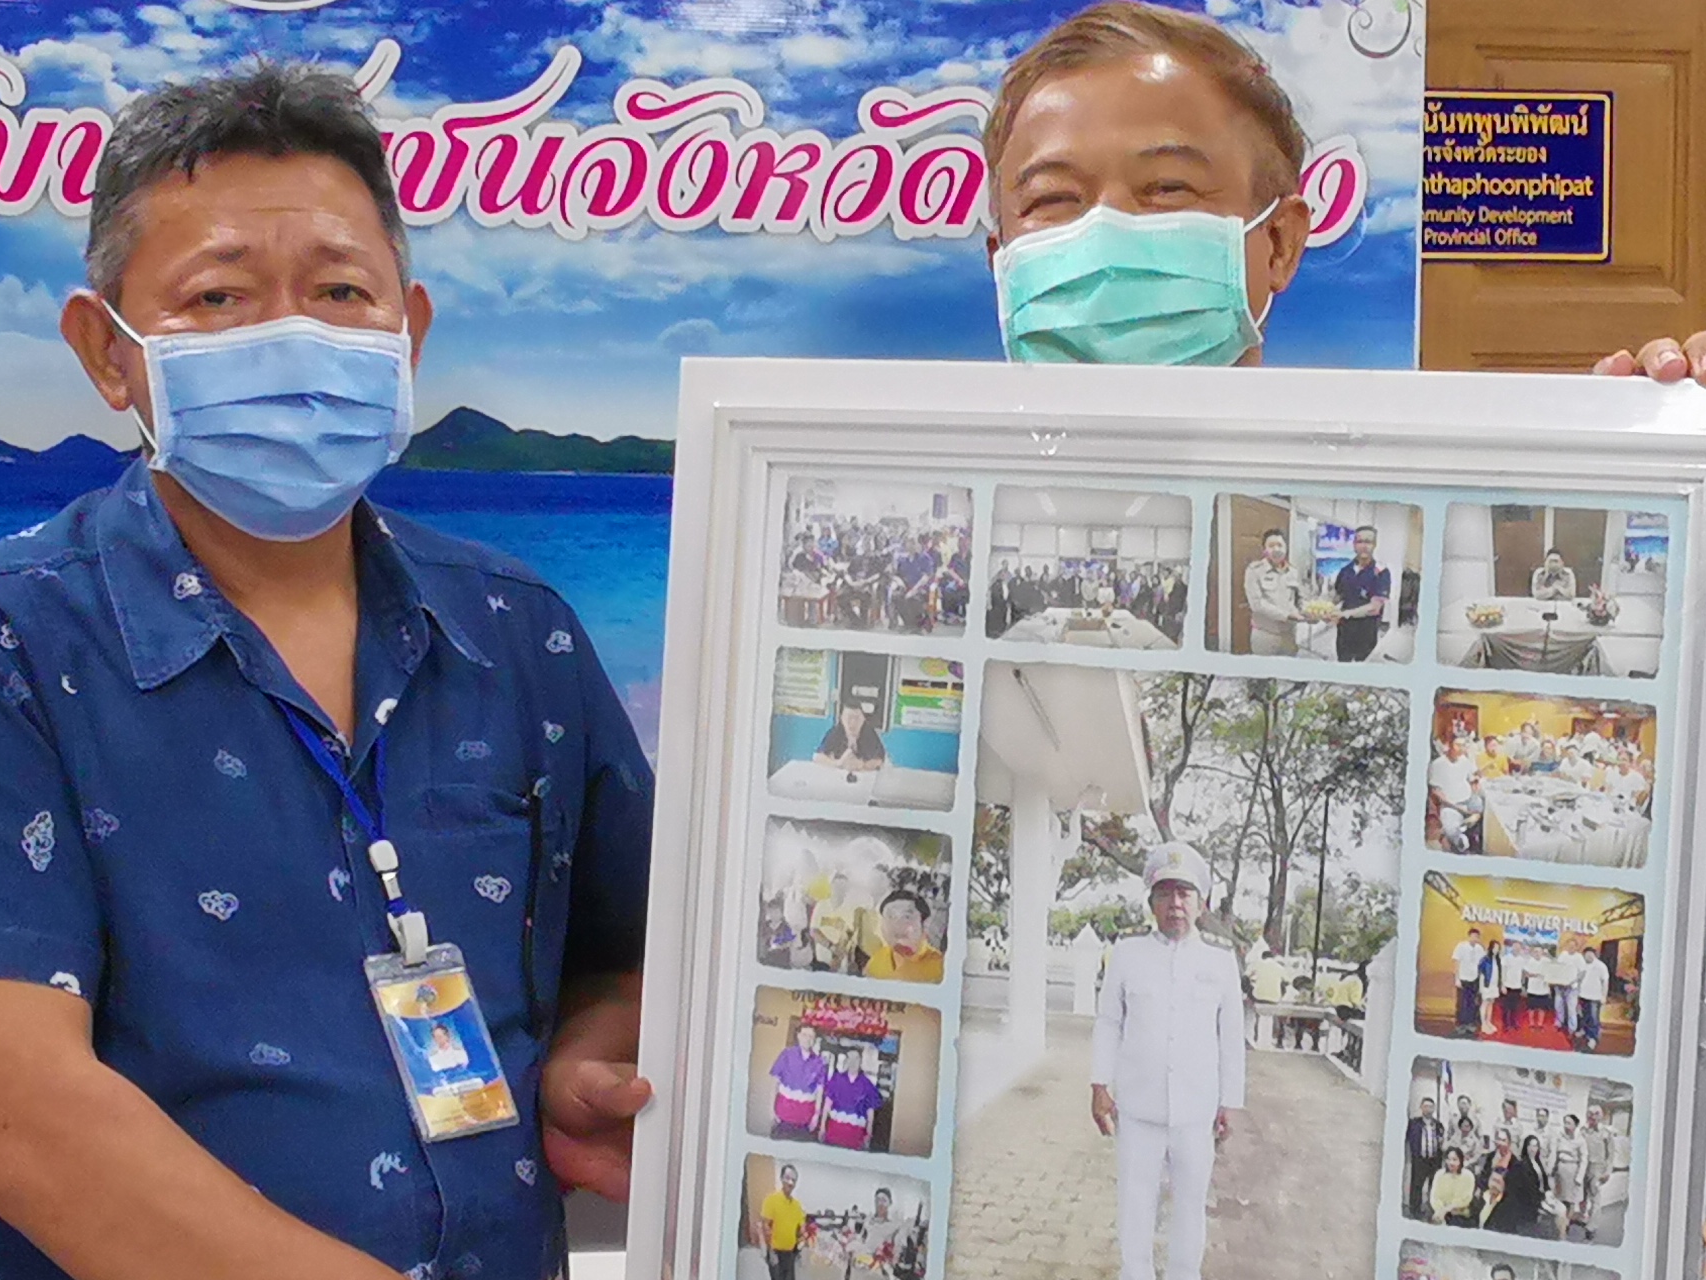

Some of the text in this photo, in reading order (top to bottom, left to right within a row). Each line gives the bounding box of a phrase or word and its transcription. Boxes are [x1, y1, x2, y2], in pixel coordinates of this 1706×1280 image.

[1423, 138, 1547, 163] ารจังหวัดระยอง
[1422, 172, 1593, 200] nthaphoonphipat
[1421, 205, 1573, 227] munity Development
[1424, 228, 1538, 245] Provincial Office
[1461, 904, 1599, 934] ANANTA RIVER HILLS
